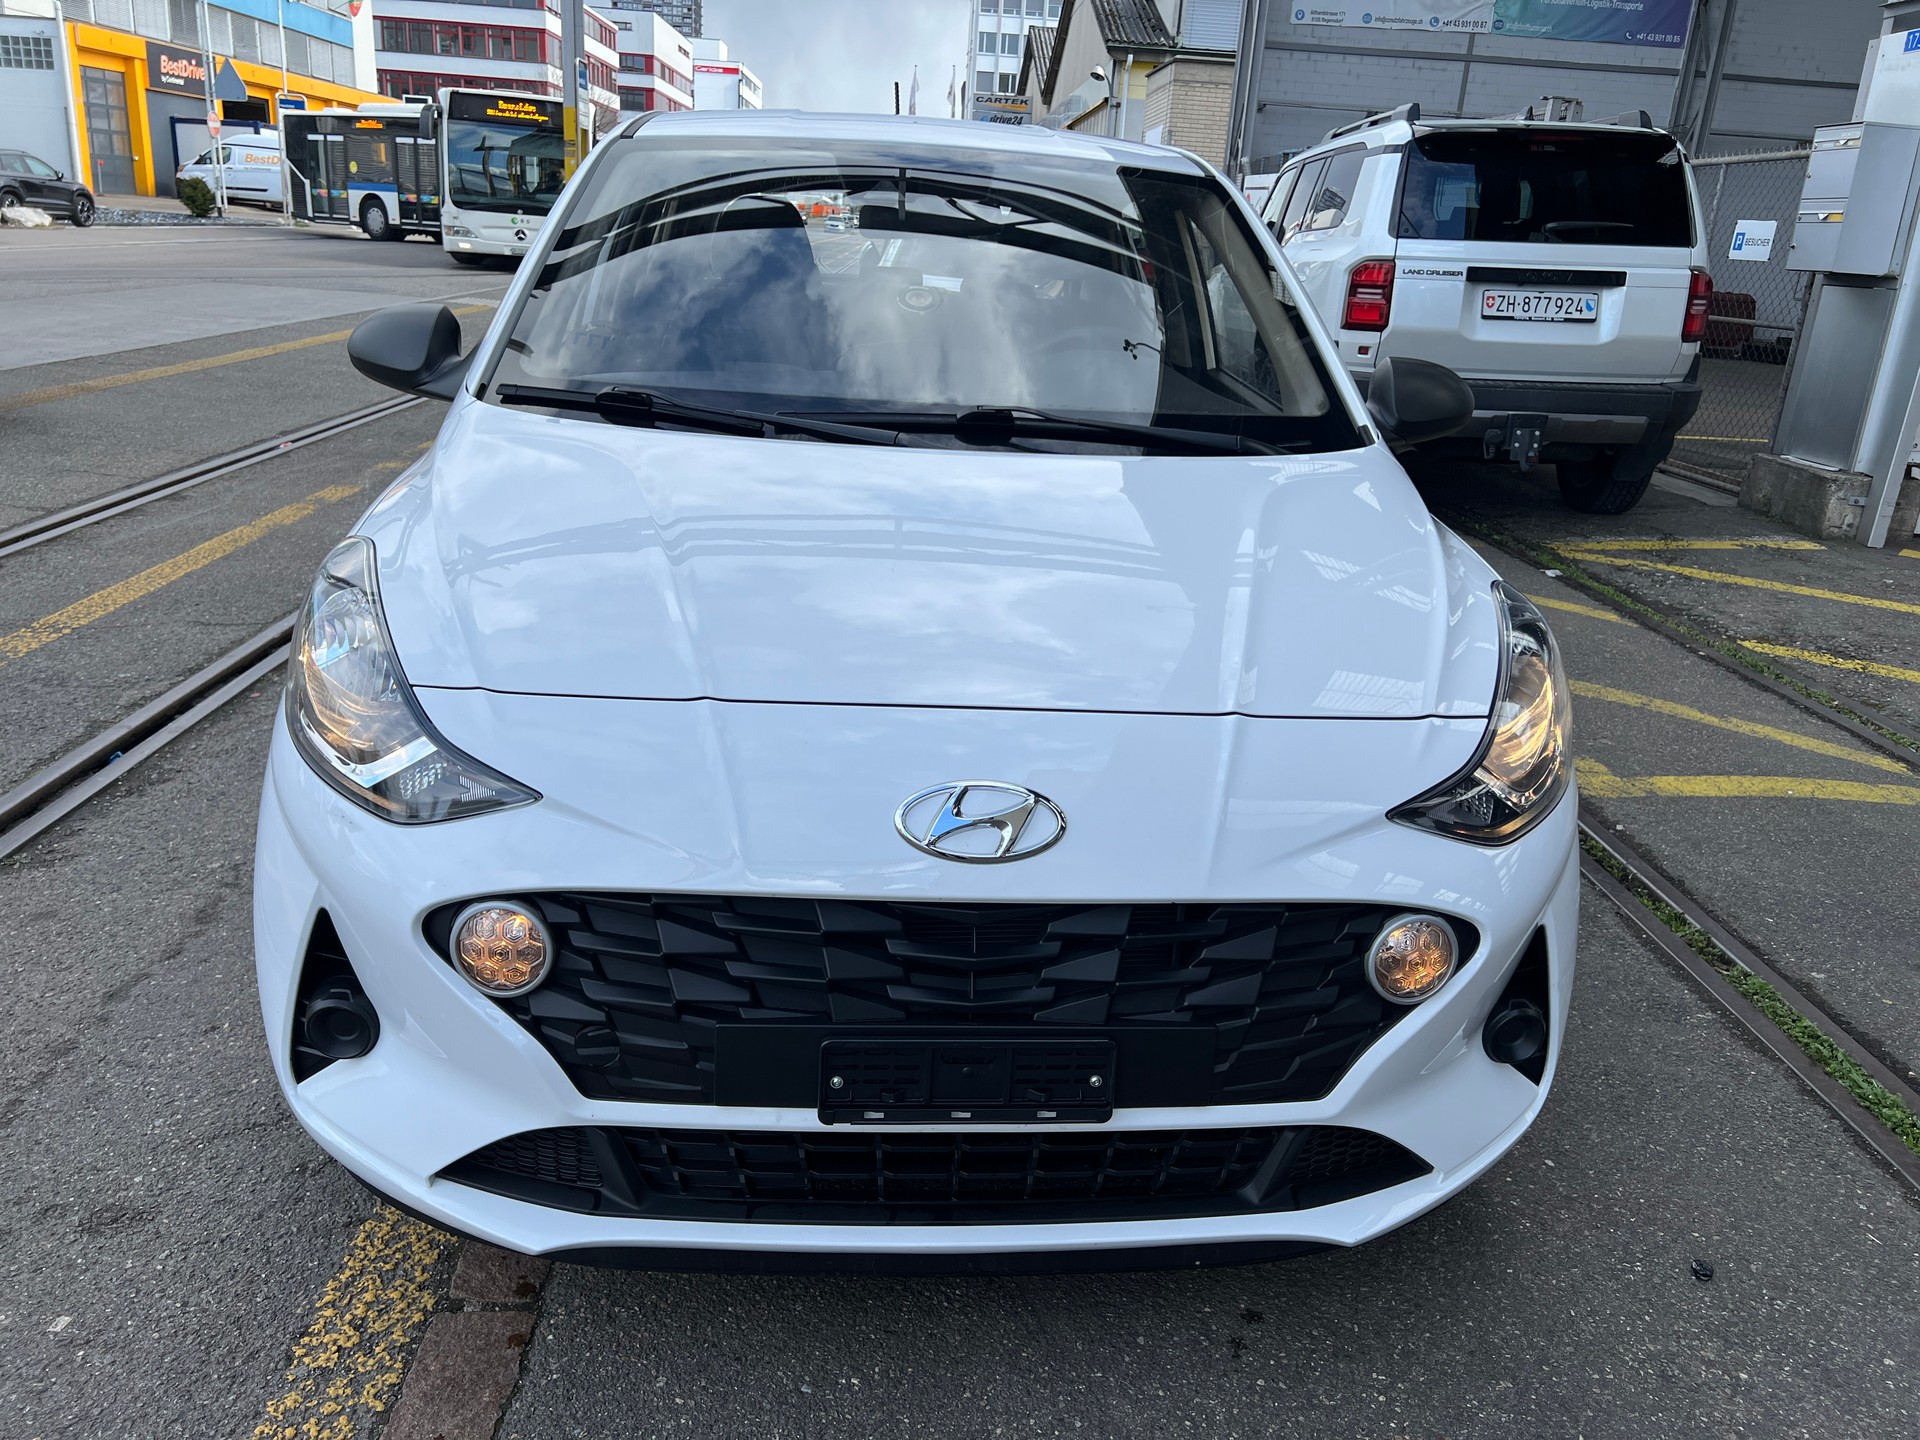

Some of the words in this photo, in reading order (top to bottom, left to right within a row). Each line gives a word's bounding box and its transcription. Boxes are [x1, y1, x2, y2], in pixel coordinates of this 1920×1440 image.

[1461, 20, 1471, 28] 931
[1472, 20, 1479, 28] 00
[1480, 21, 1488, 29] 87
[1647, 33, 1654, 41] 43
[1665, 34, 1673, 42] 00
[1673, 35, 1681, 43] 85
[1908, 33, 1920, 48] 17
[160, 55, 206, 80] BestDrive
[976, 97, 1029, 105] CARTEK
[1744, 237, 1771, 247] BESUCHER
[1426, 269, 1463, 277] CRUISER
